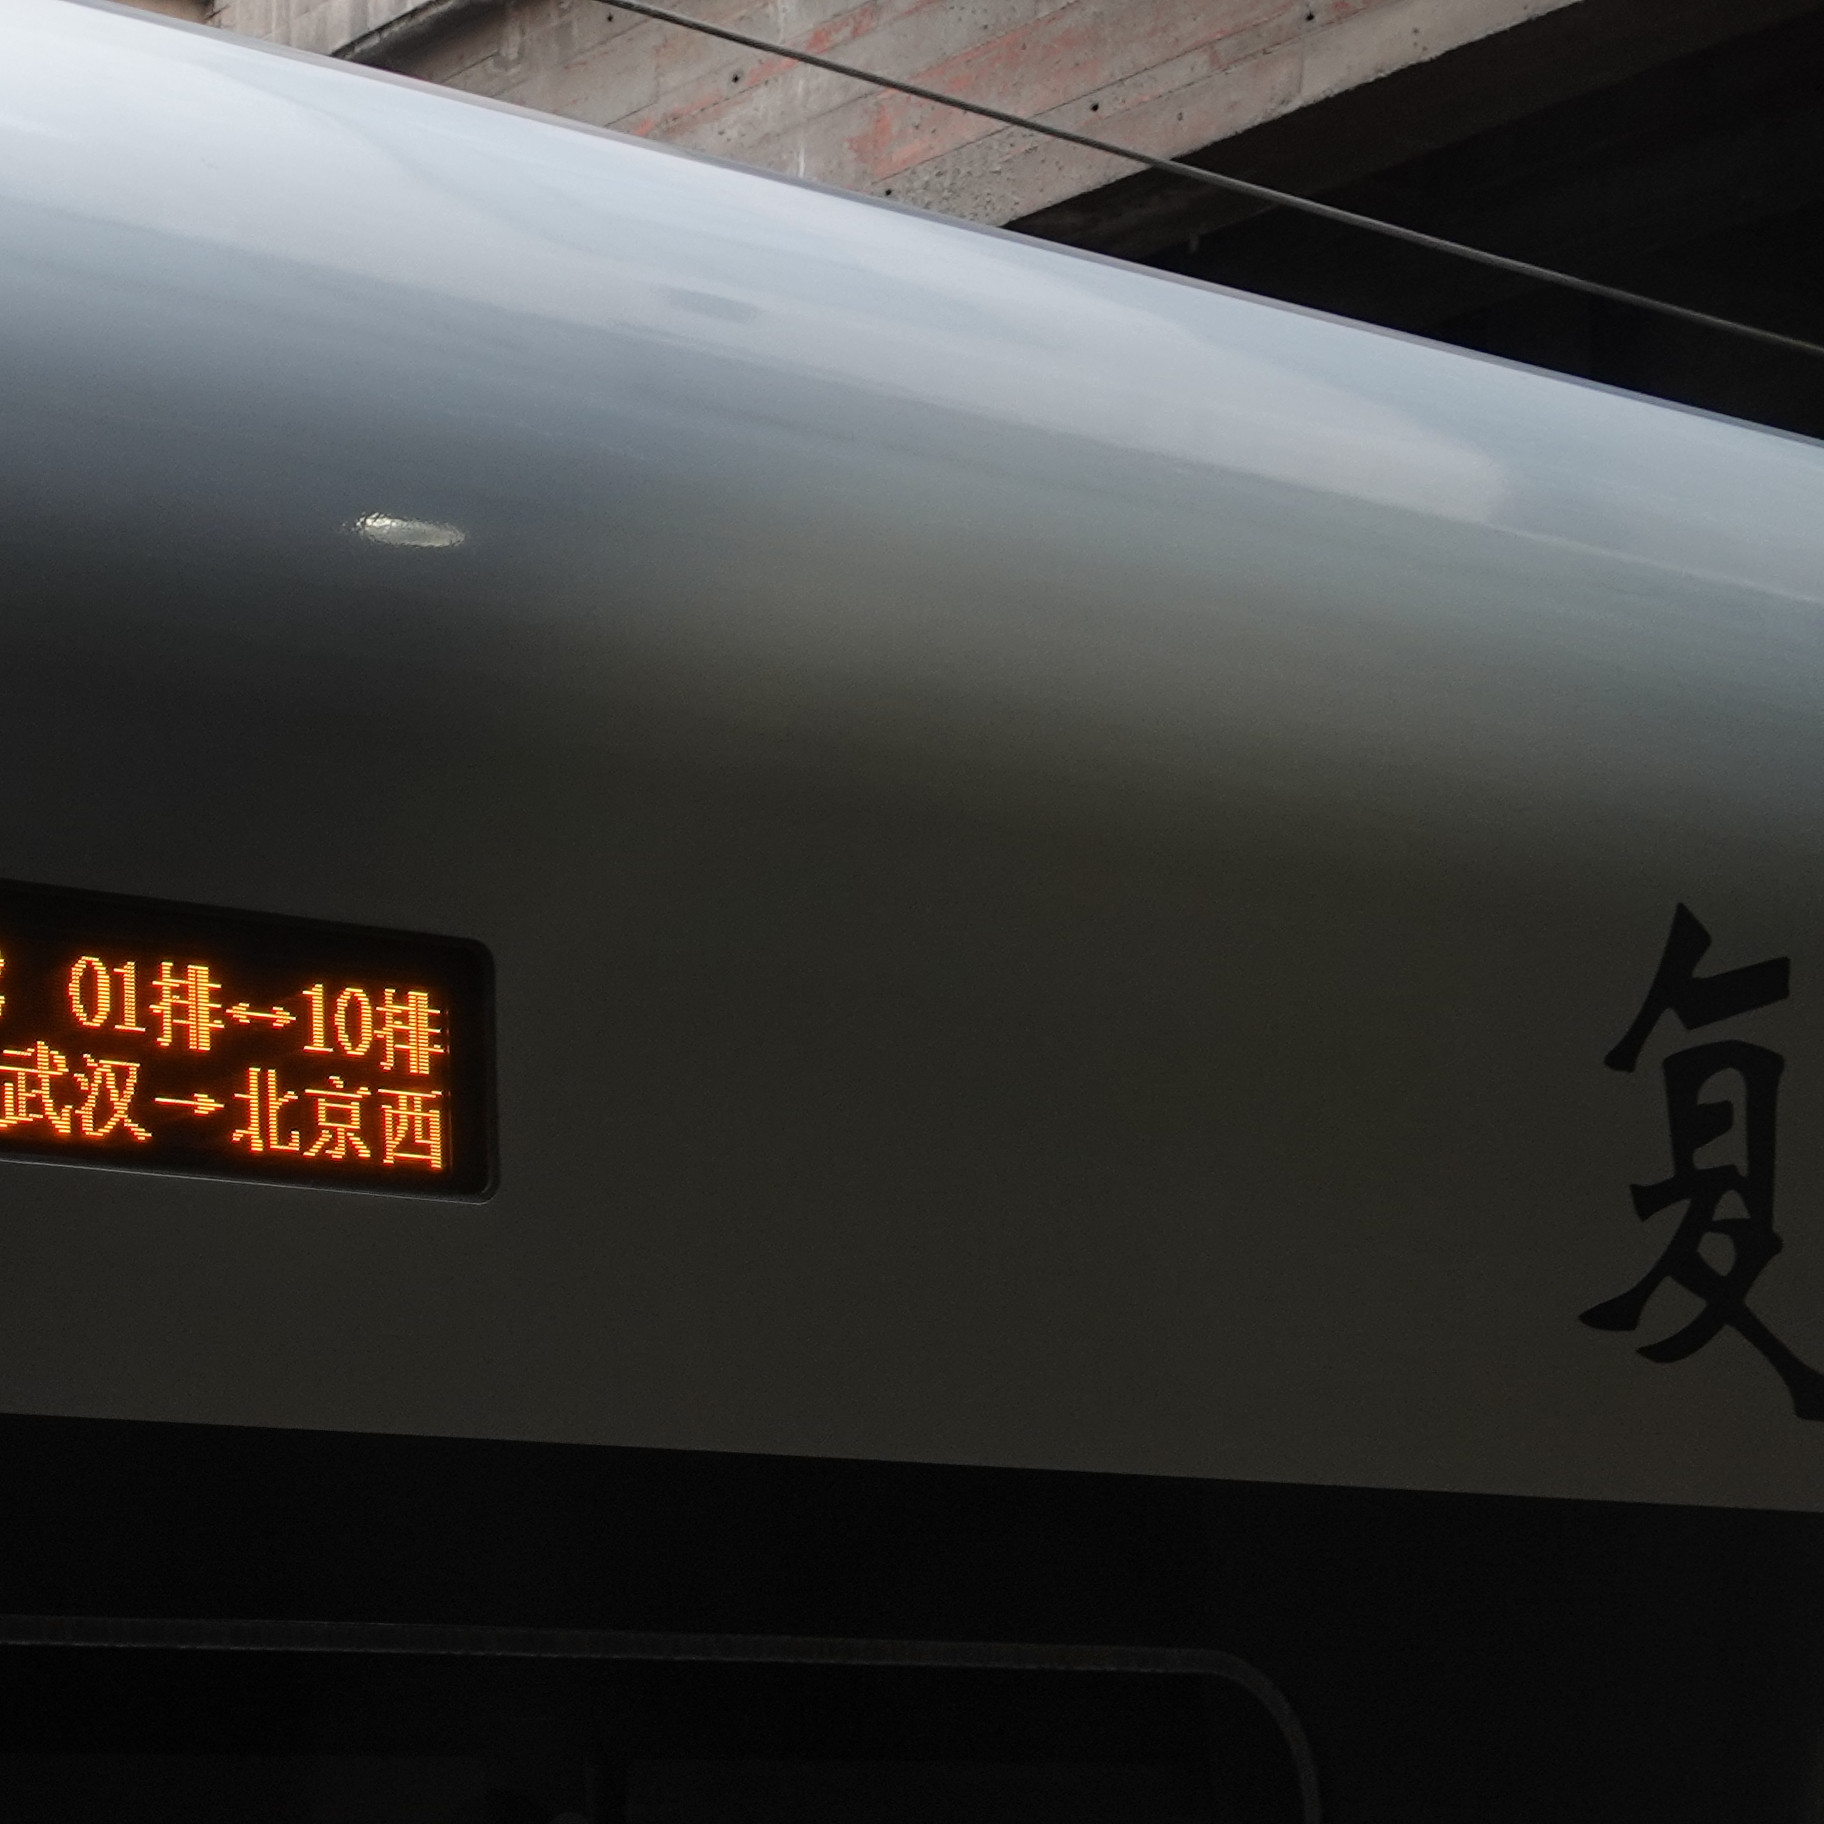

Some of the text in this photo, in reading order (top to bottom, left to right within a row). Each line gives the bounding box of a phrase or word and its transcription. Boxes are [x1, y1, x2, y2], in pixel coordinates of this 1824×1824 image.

[232, 1067, 444, 1169] 北京西
[1578, 903, 1824, 1421] 复
